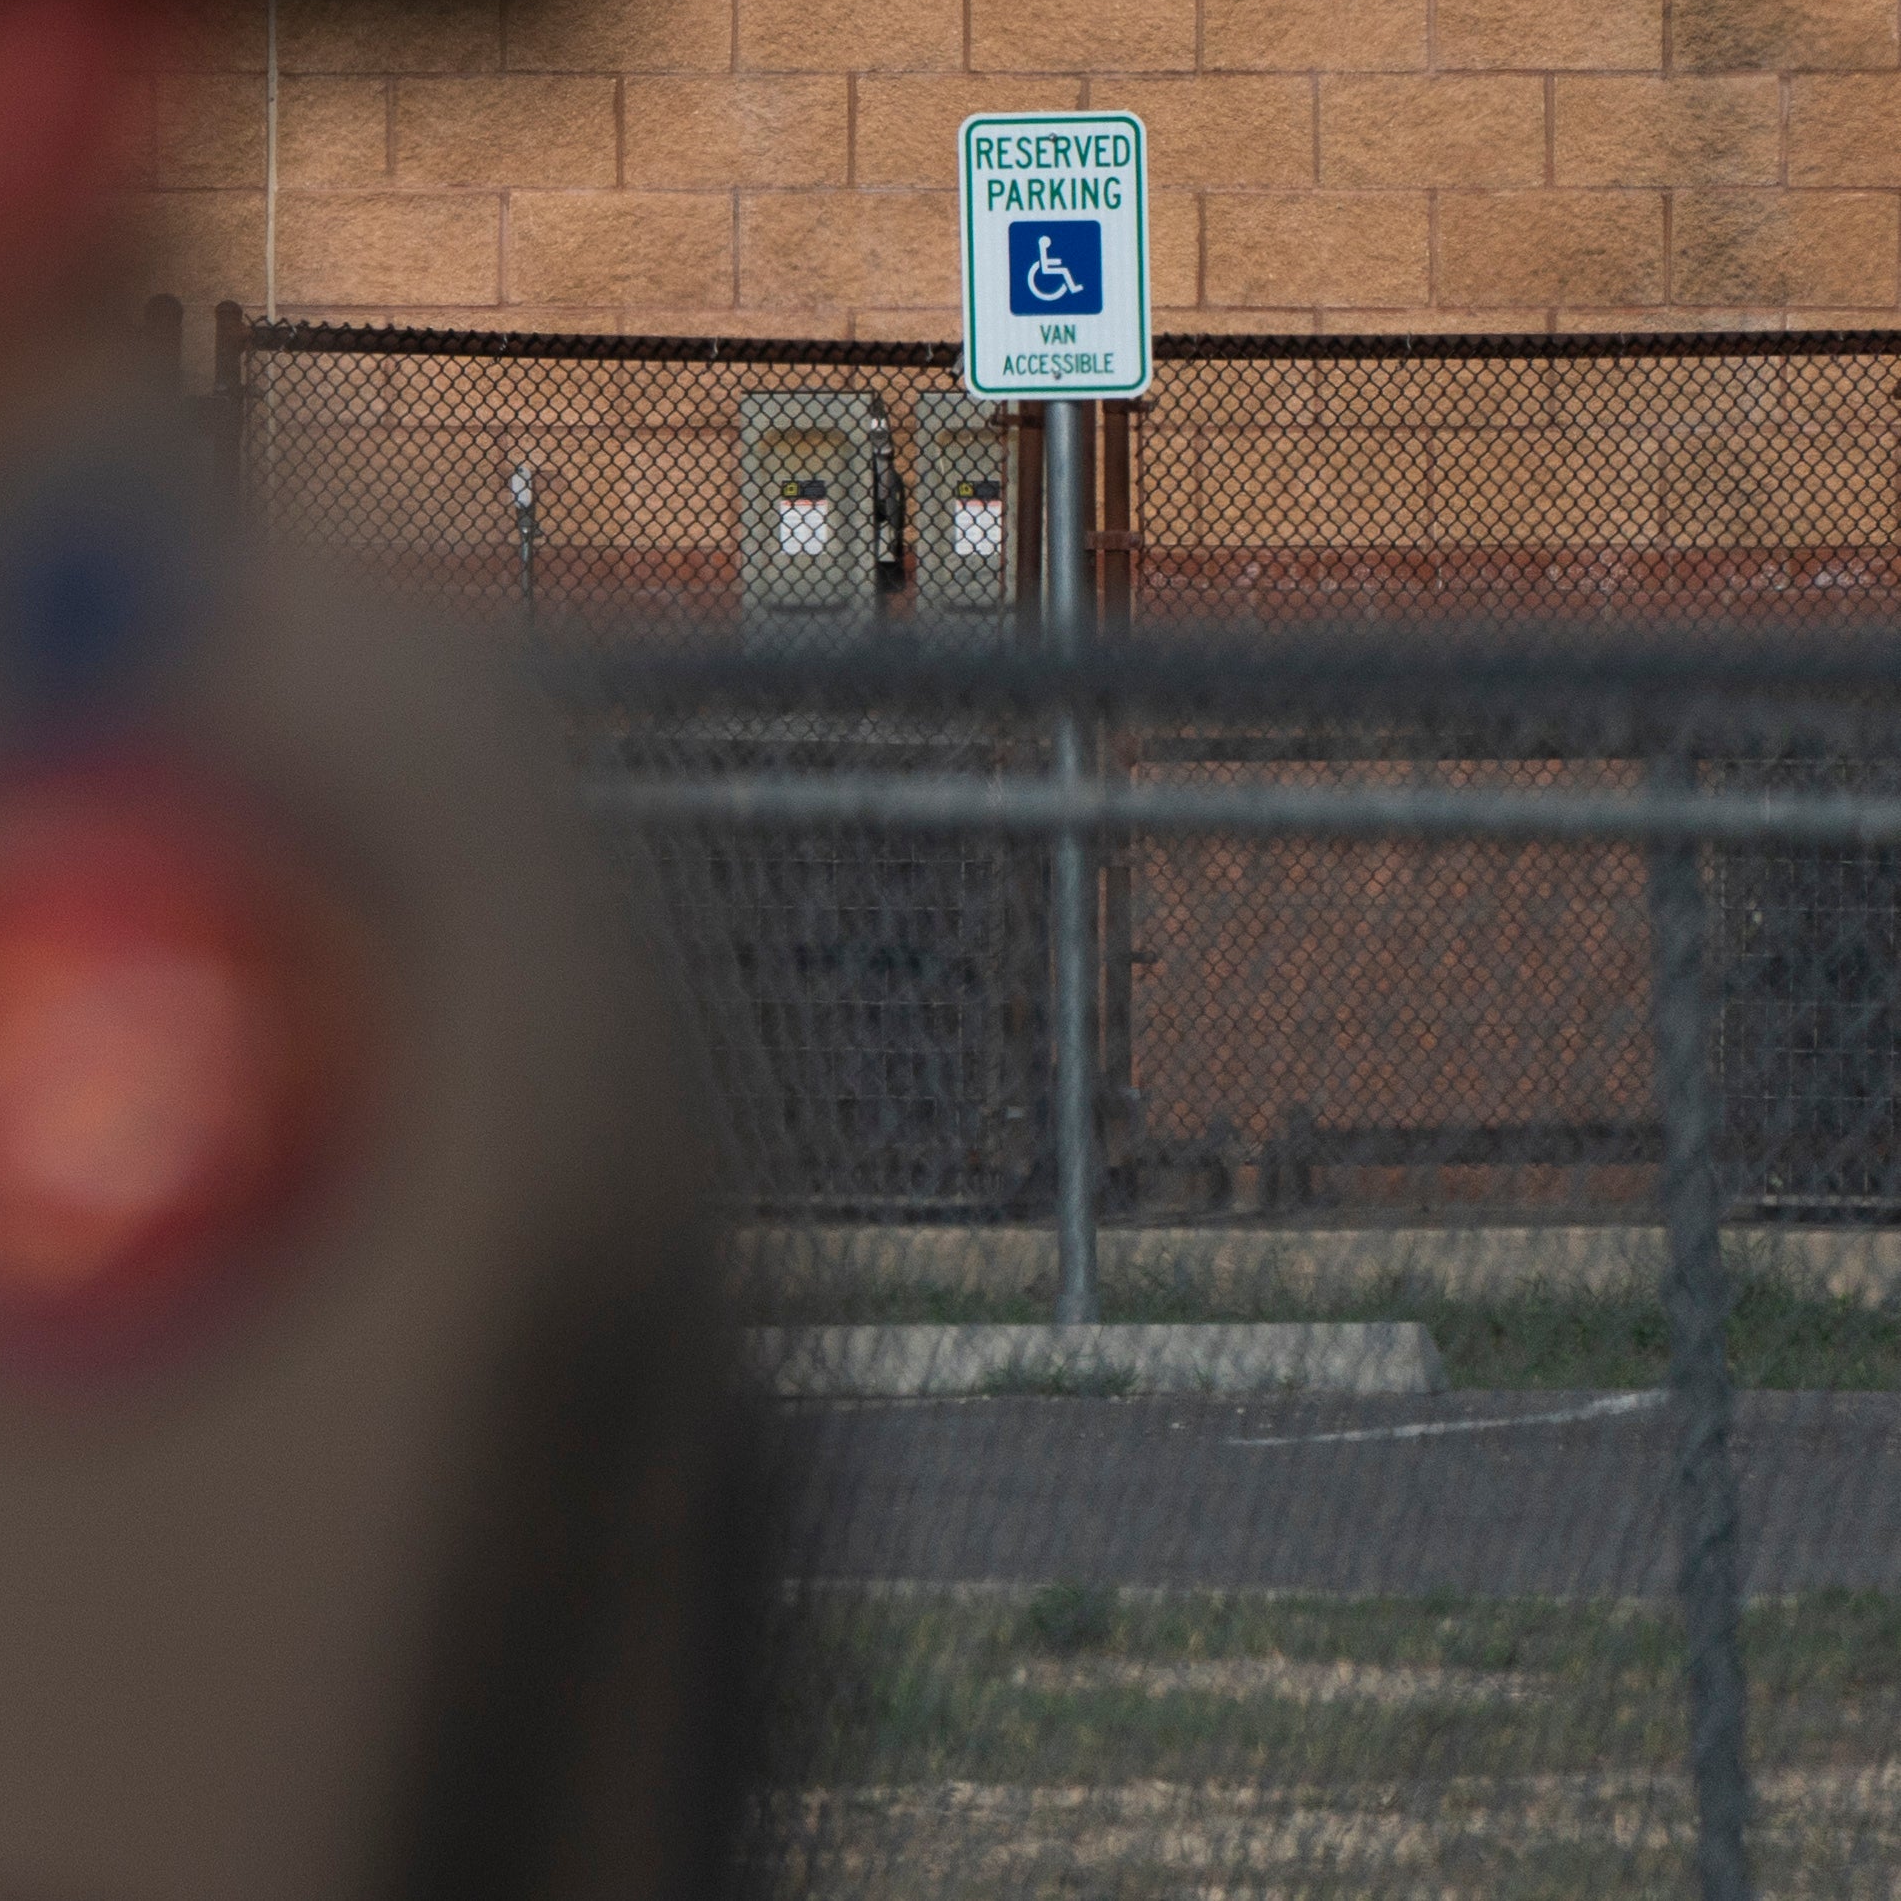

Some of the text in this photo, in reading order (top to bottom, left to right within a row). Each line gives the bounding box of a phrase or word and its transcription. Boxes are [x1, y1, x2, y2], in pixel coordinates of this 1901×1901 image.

[976, 135, 1131, 169] RESERVED
[988, 177, 1121, 211] PARKING
[1040, 324, 1076, 344] VAN
[1003, 352, 1114, 375] ACCESSIBLE
